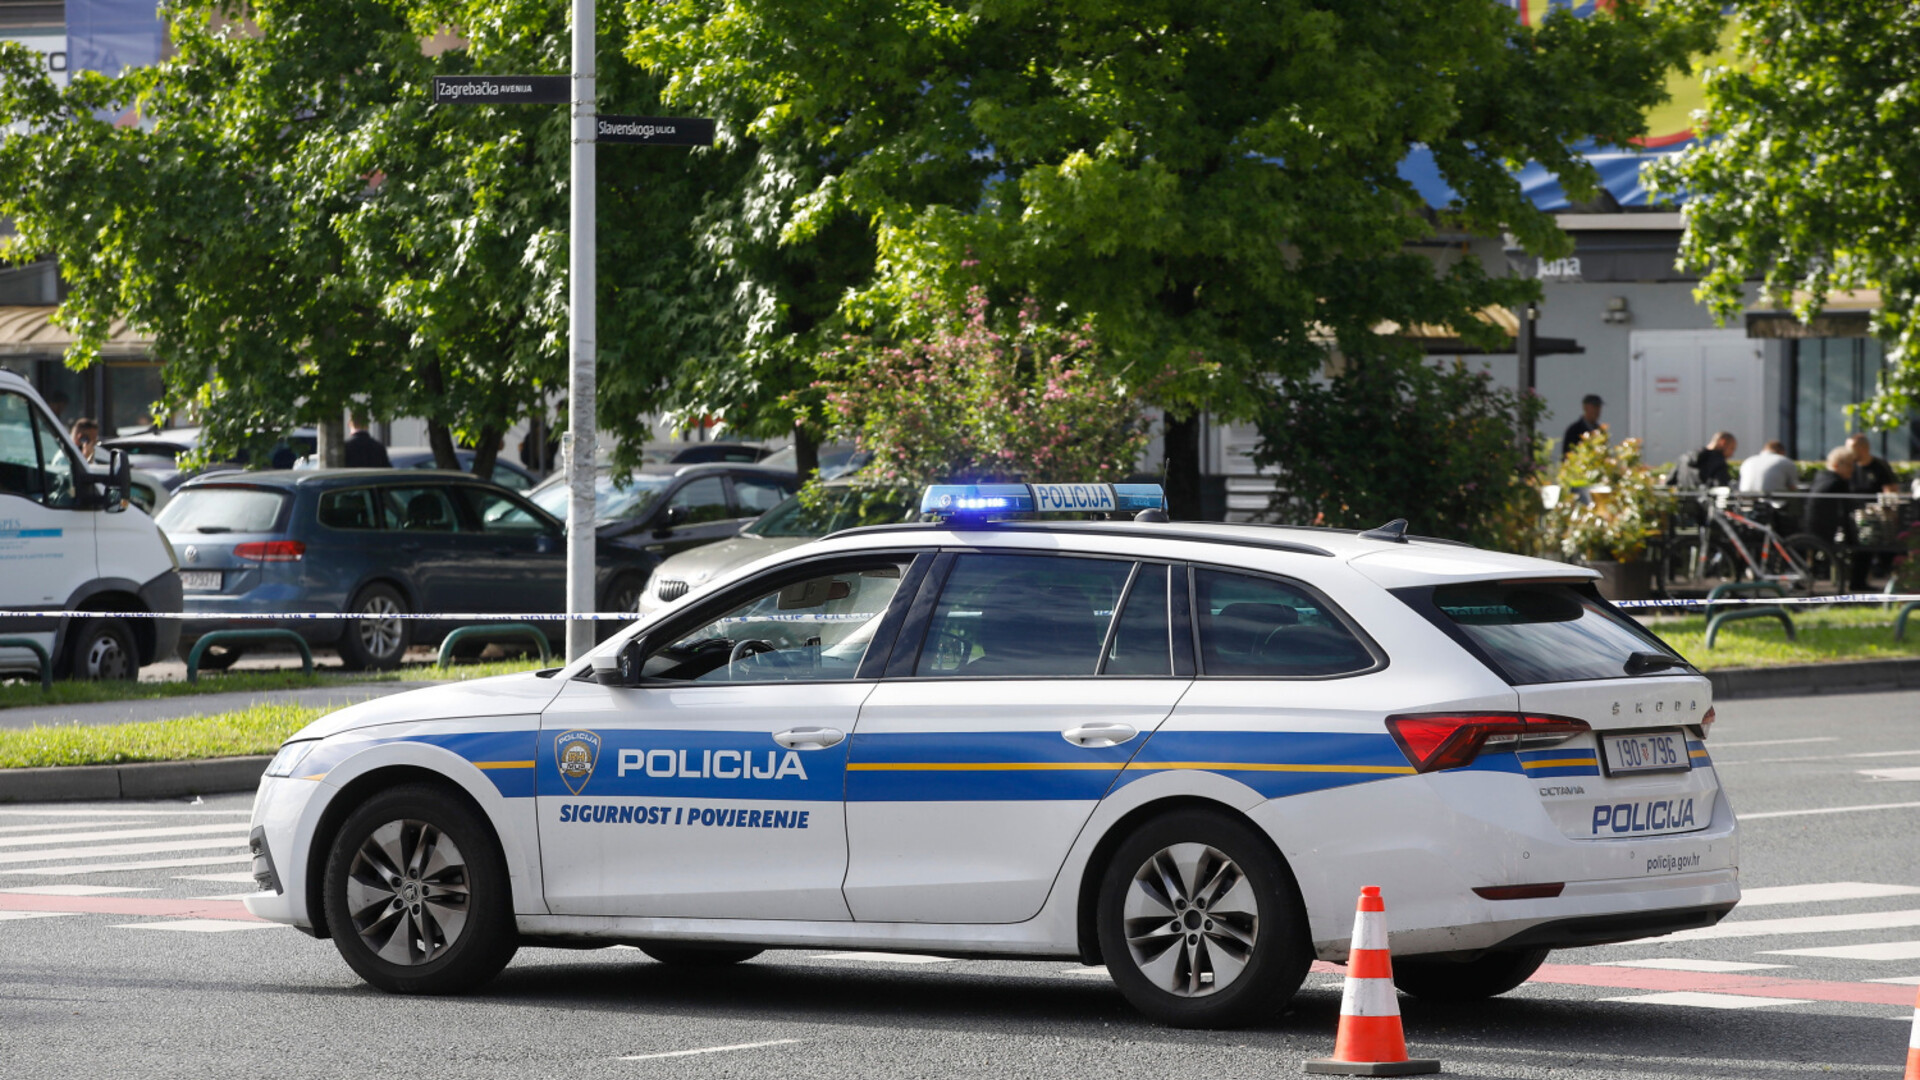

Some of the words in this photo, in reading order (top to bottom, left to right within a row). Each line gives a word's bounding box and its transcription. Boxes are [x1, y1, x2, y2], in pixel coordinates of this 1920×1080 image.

[440, 81, 499, 99] Zagrebačka
[500, 85, 533, 93] AVENIJA
[598, 121, 655, 139] Slavenskoga
[656, 126, 676, 134] ULICA
[1036, 485, 1112, 508] POLICIJA
[558, 733, 598, 745] POLICIJA
[1616, 740, 1642, 767] 190
[1648, 737, 1677, 764] 796
[617, 749, 809, 781] POLICIJA
[1539, 786, 1585, 797] OCTAVIA
[559, 804, 672, 825] SIGURNOST
[674, 807, 684, 826] I
[687, 808, 810, 829] POVJERENJE
[1592, 798, 1695, 835] POLICIJA
[1646, 852, 1701, 873] policija.gov.hr
